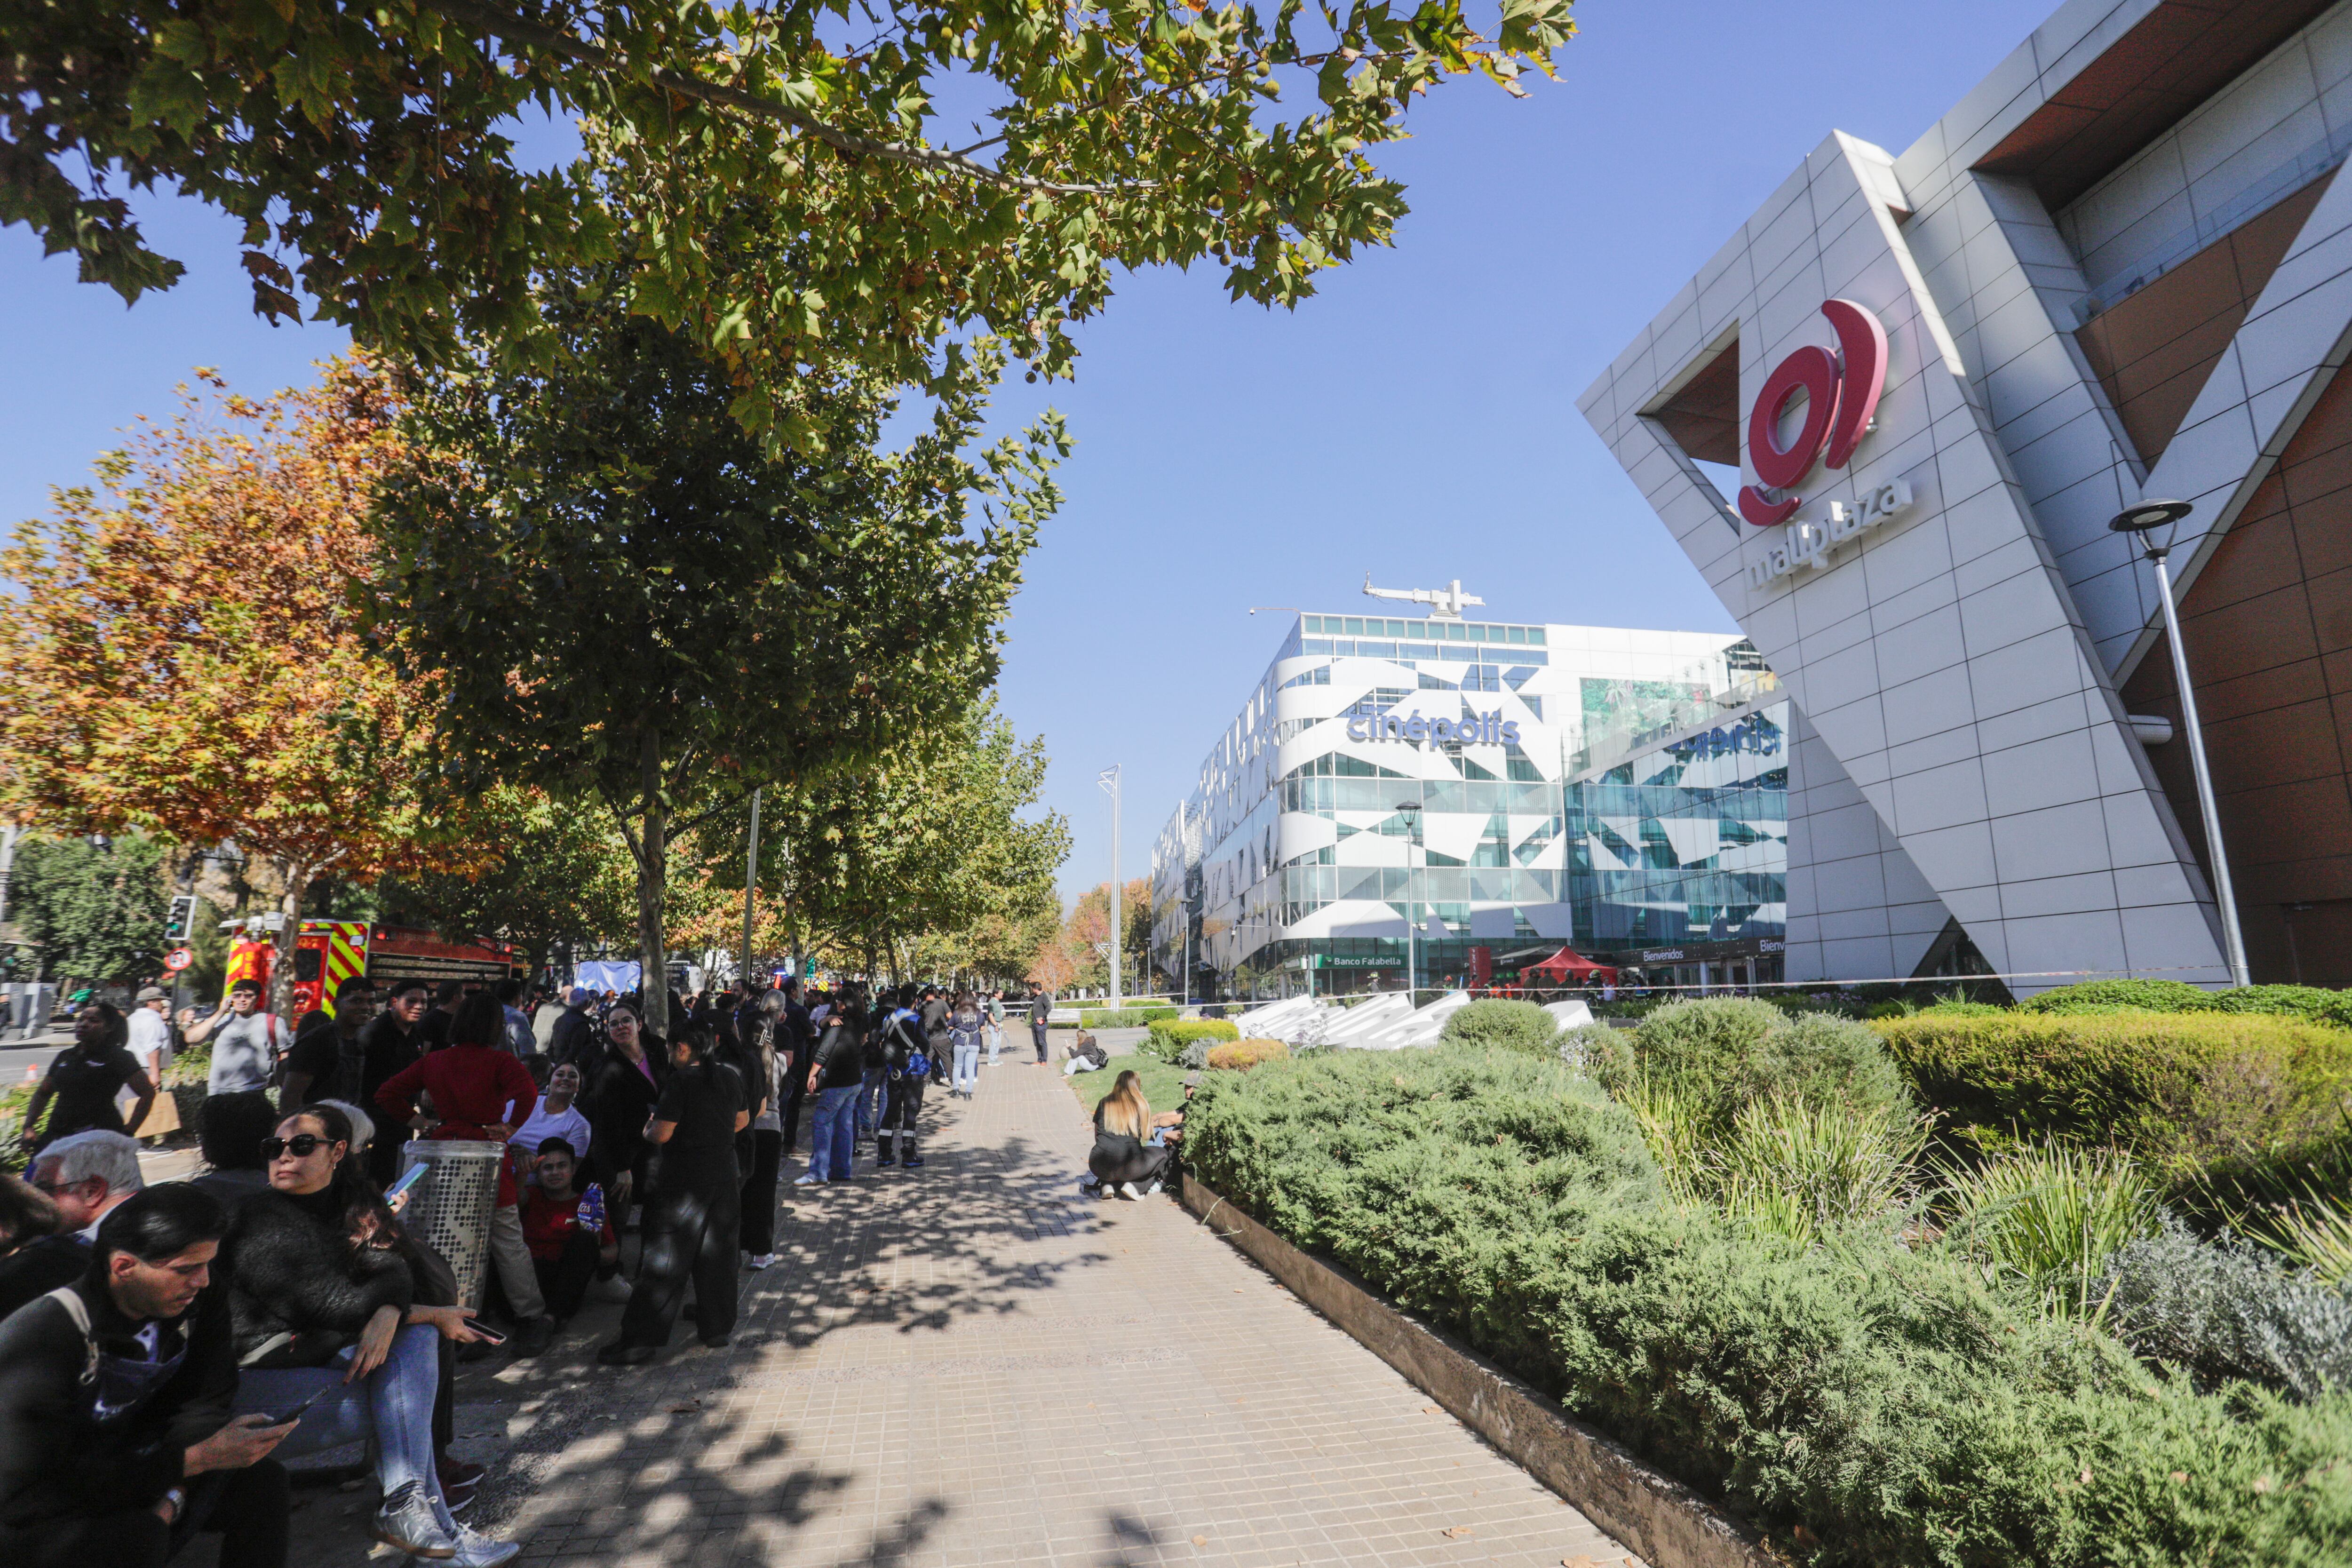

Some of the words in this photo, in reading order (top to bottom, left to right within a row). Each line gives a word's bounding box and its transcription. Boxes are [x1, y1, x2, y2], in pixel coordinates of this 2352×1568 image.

[1745, 477, 1913, 591] mallplaza
[1346, 706, 1521, 748] cinépolis
[1362, 957, 1401, 965] Falabella
[1644, 948, 1684, 962] Bienvenidos
